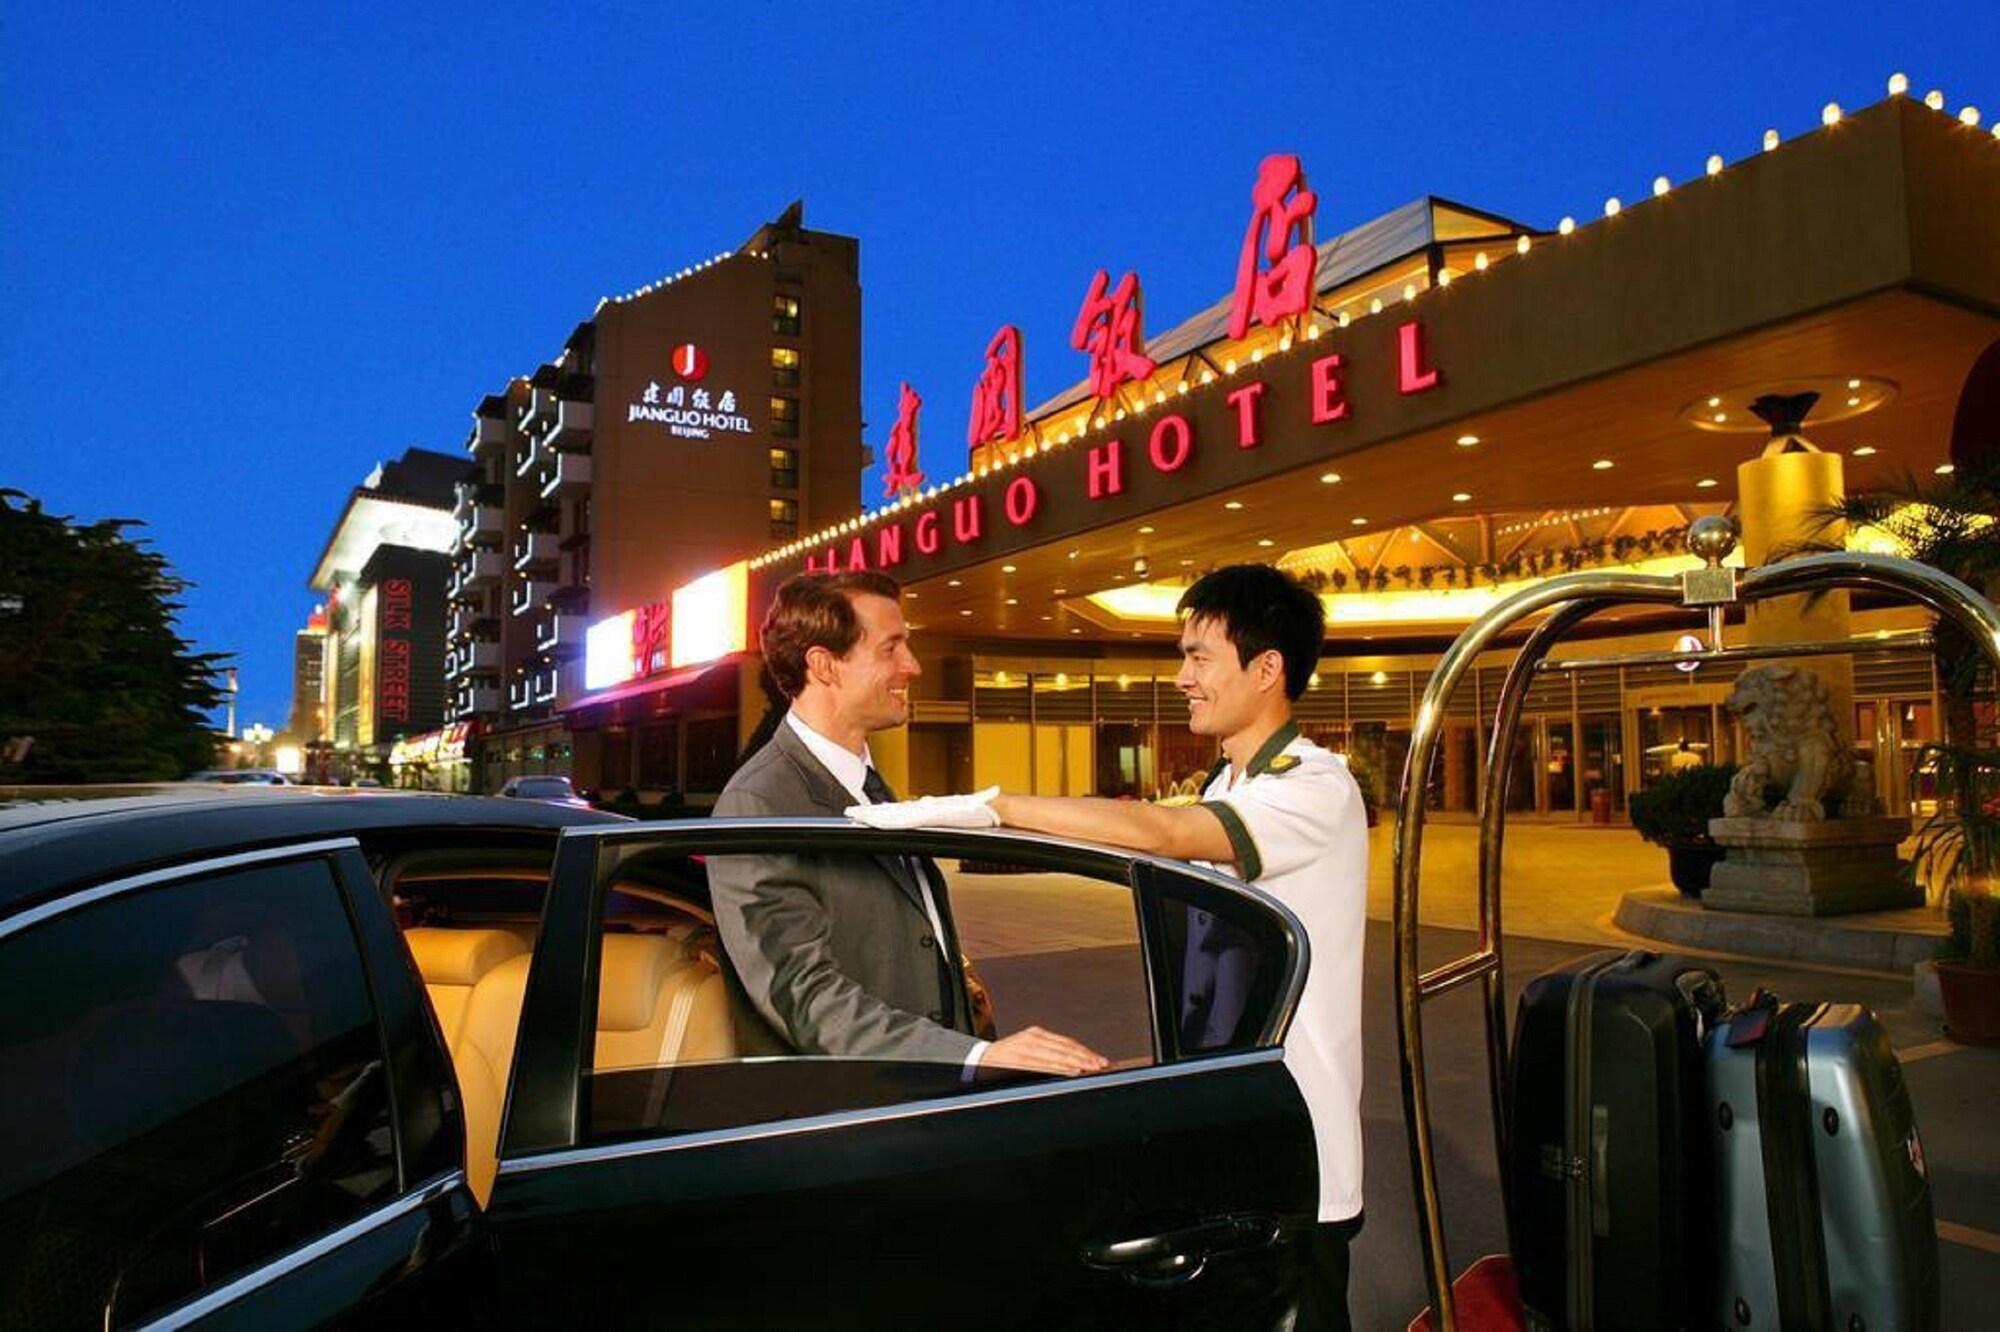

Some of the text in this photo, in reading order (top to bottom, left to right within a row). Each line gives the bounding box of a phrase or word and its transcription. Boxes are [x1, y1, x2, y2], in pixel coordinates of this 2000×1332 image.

[627, 403, 752, 433] JIANGUO HOTEL
[671, 425, 709, 438] BEIJING
[1087, 321, 1439, 499] HOTEL
[382, 578, 412, 722] SILK STREET
